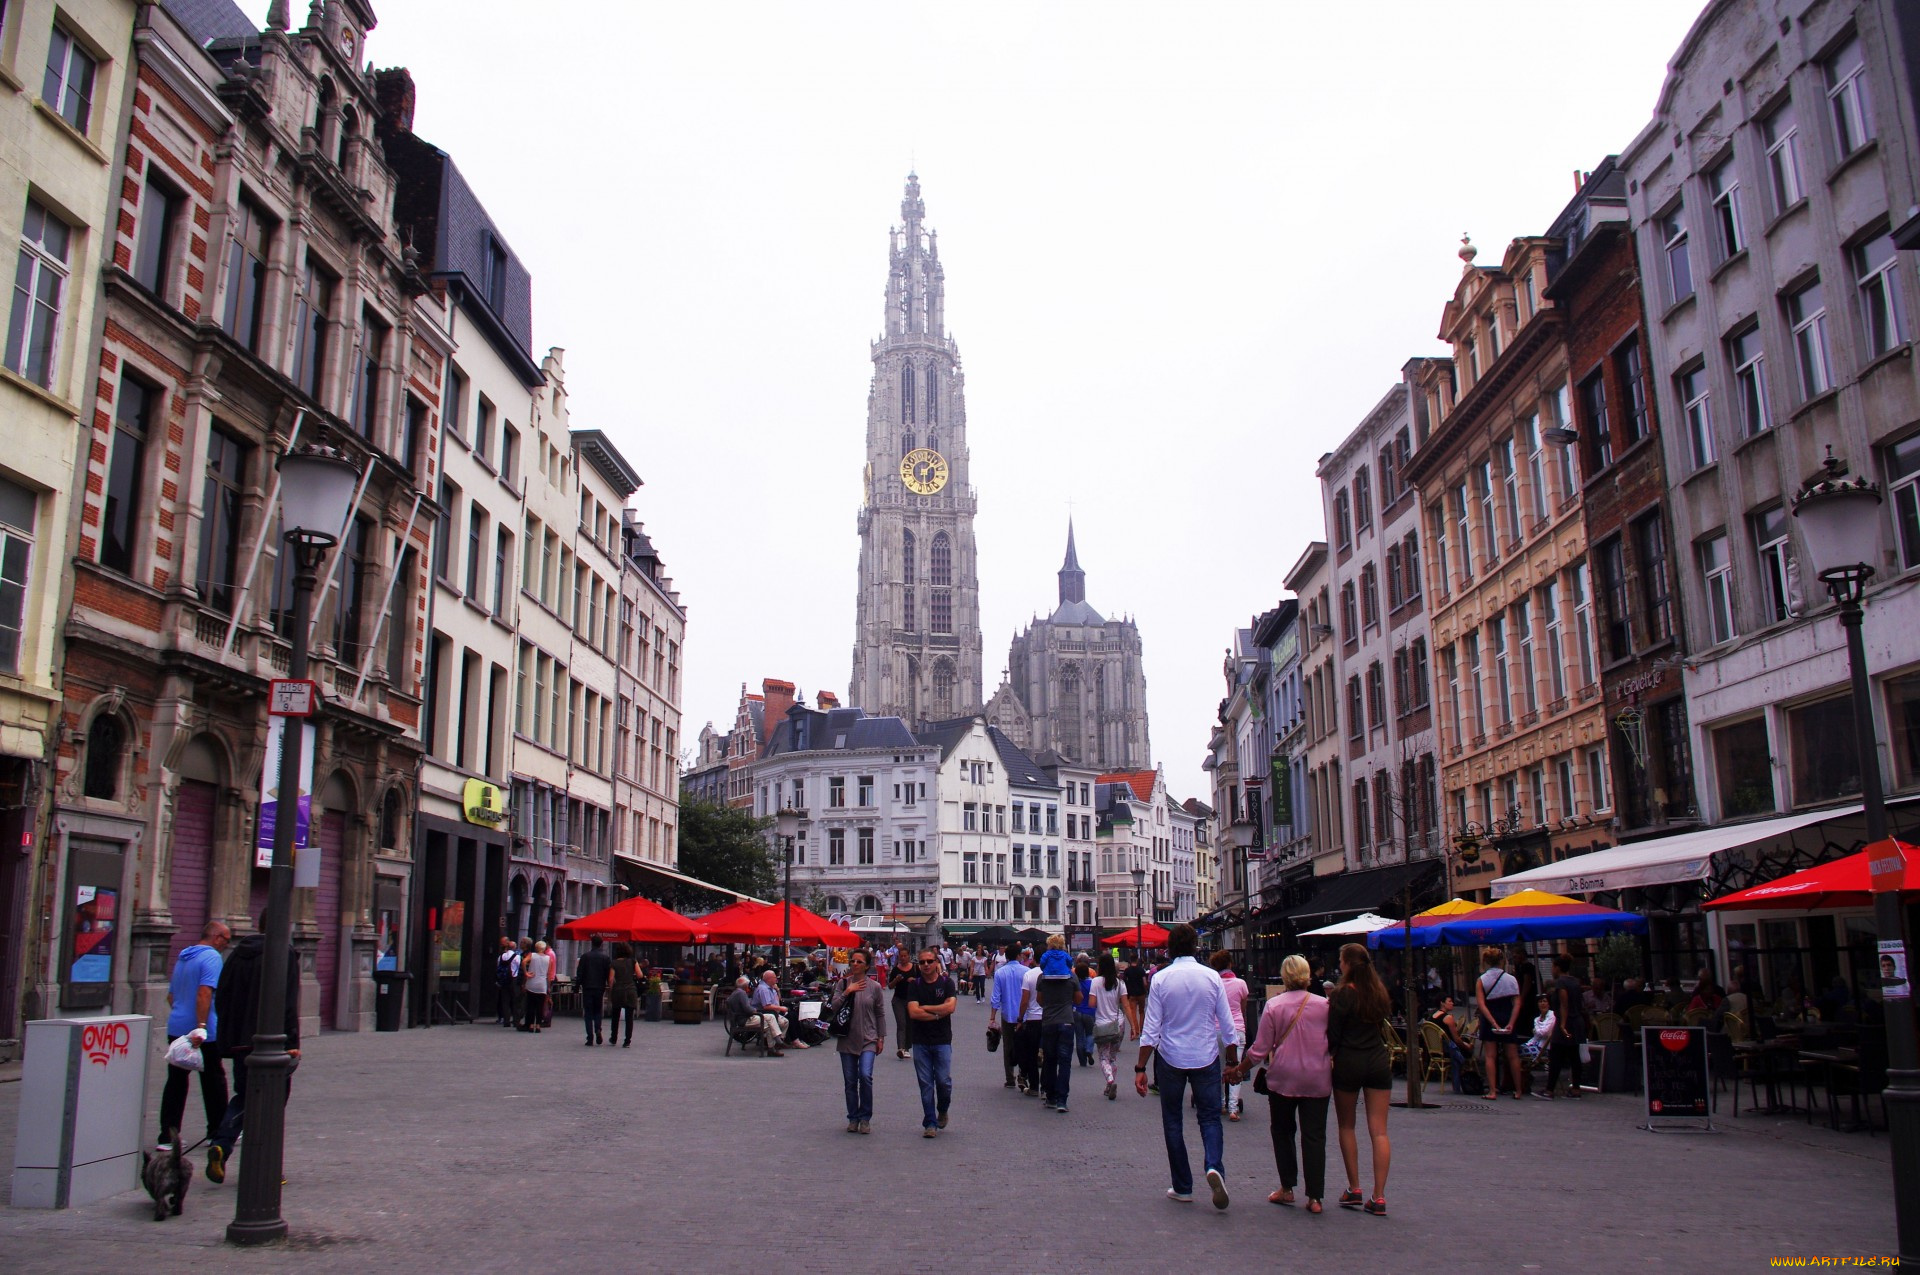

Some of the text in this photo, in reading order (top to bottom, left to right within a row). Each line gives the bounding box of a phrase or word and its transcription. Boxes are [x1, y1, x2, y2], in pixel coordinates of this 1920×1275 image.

[280, 683, 303, 691] H150
[1623, 668, 1662, 695] Geveltje
[1251, 792, 1261, 847] ROSARIO
[1569, 877, 1605, 891] De Bomma
